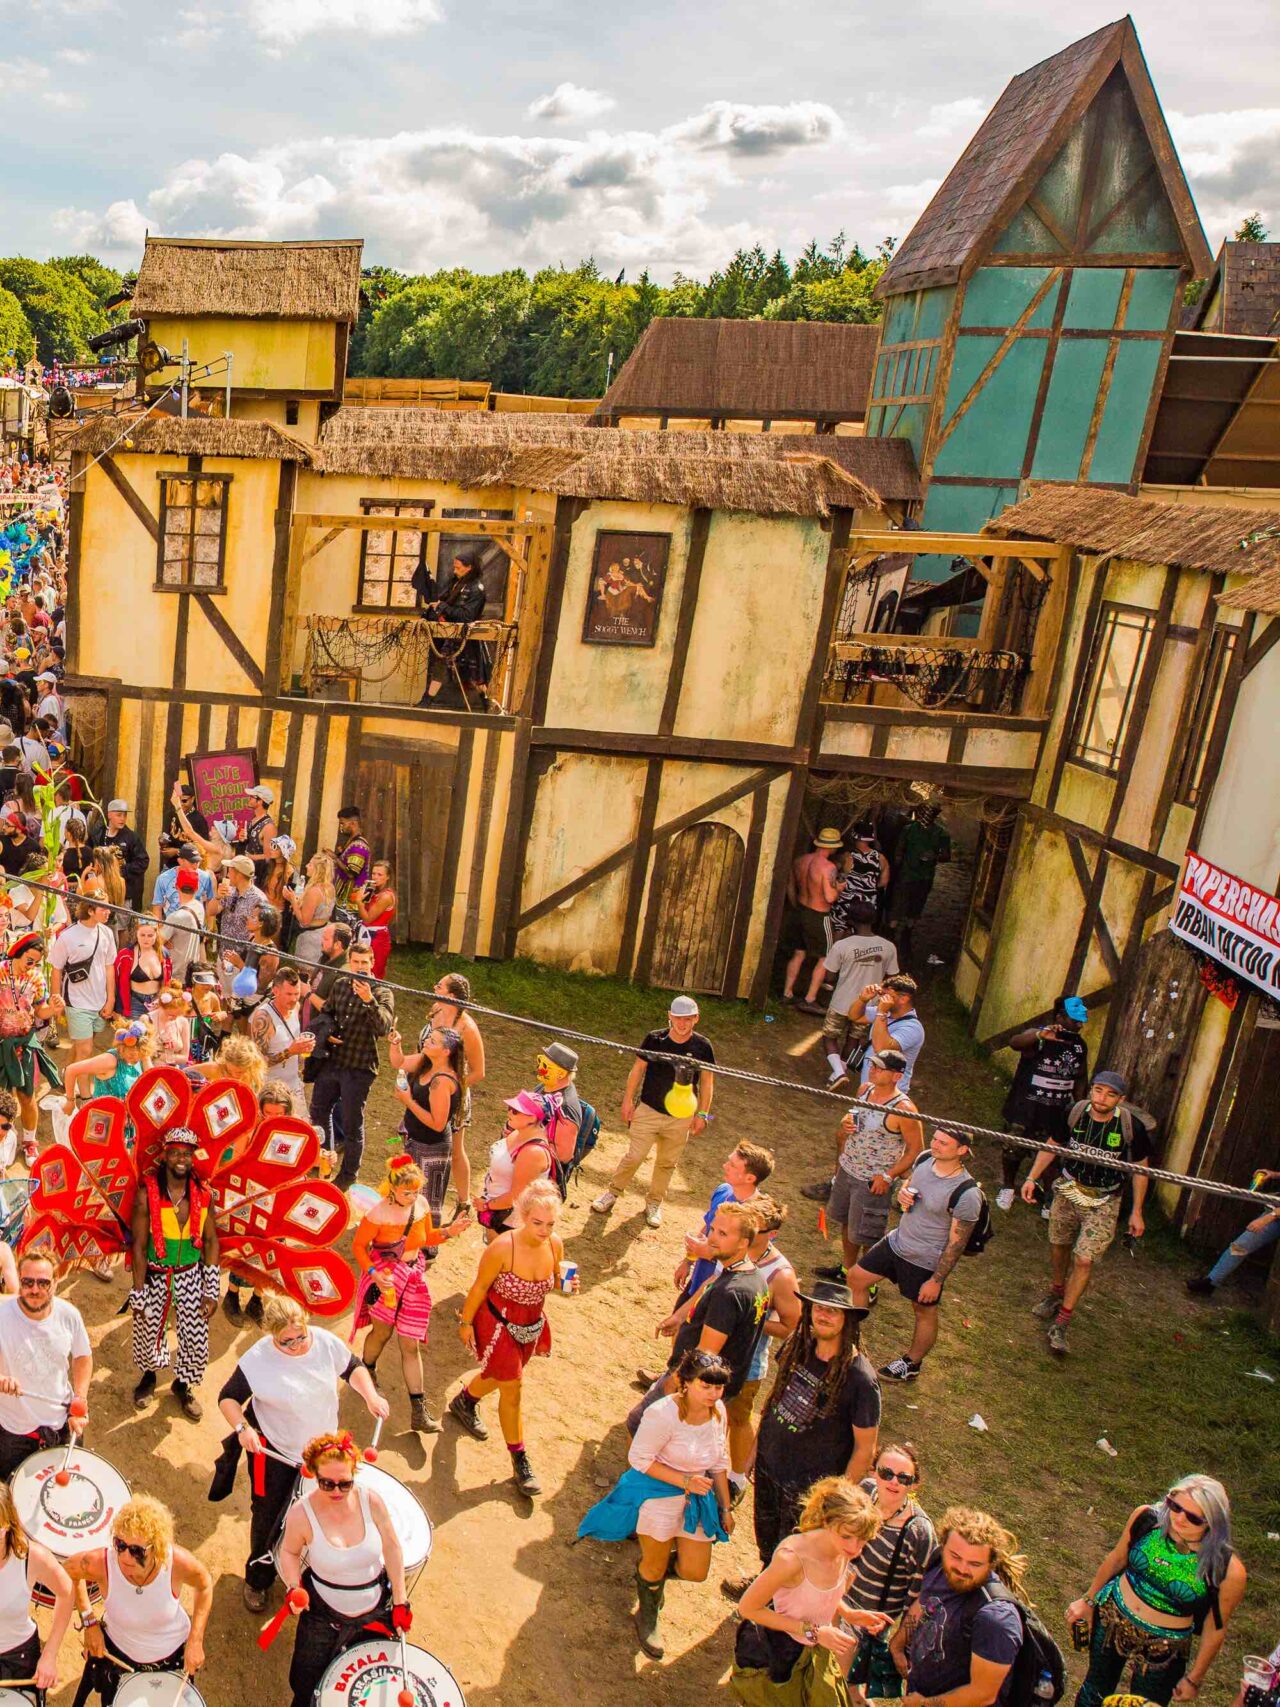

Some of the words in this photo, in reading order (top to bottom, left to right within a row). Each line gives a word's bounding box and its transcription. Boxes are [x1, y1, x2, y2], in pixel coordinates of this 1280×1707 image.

[201, 765, 240, 785] LATE
[1217, 925, 1274, 981] TATTOO
[334, 1651, 388, 1692] BATALA
